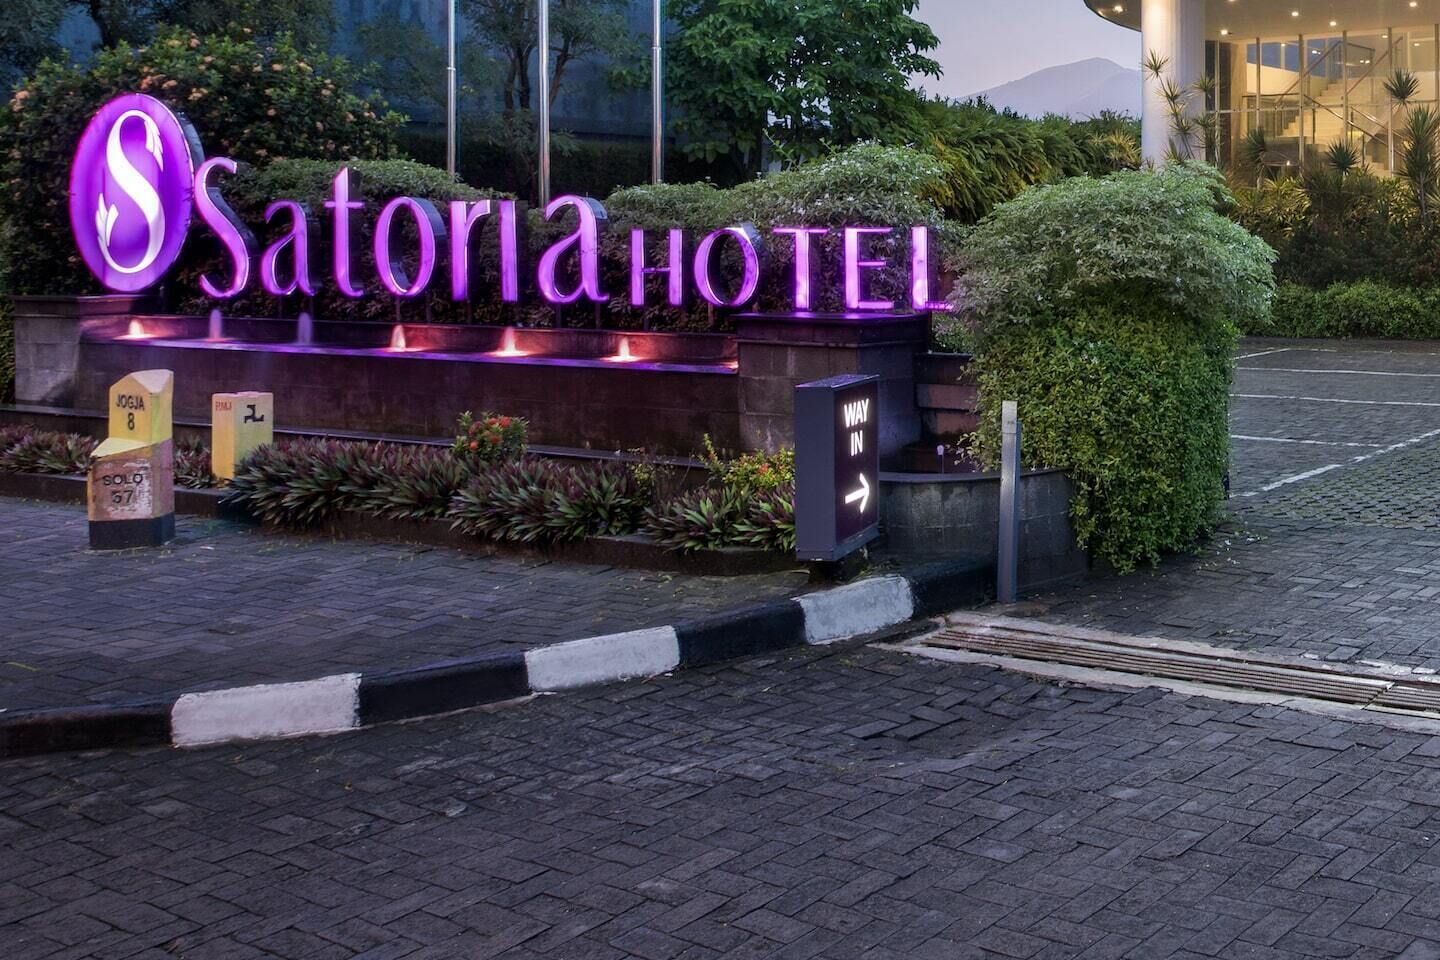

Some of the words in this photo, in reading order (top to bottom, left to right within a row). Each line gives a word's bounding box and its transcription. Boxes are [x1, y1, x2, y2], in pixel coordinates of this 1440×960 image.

[194, 156, 609, 306] Satoria
[630, 224, 954, 311] HOTEL
[115, 394, 145, 411] JOGJA
[843, 398, 870, 428] WAY
[127, 412, 135, 431] 8
[850, 430, 864, 457] IN
[103, 473, 144, 487] SOLO
